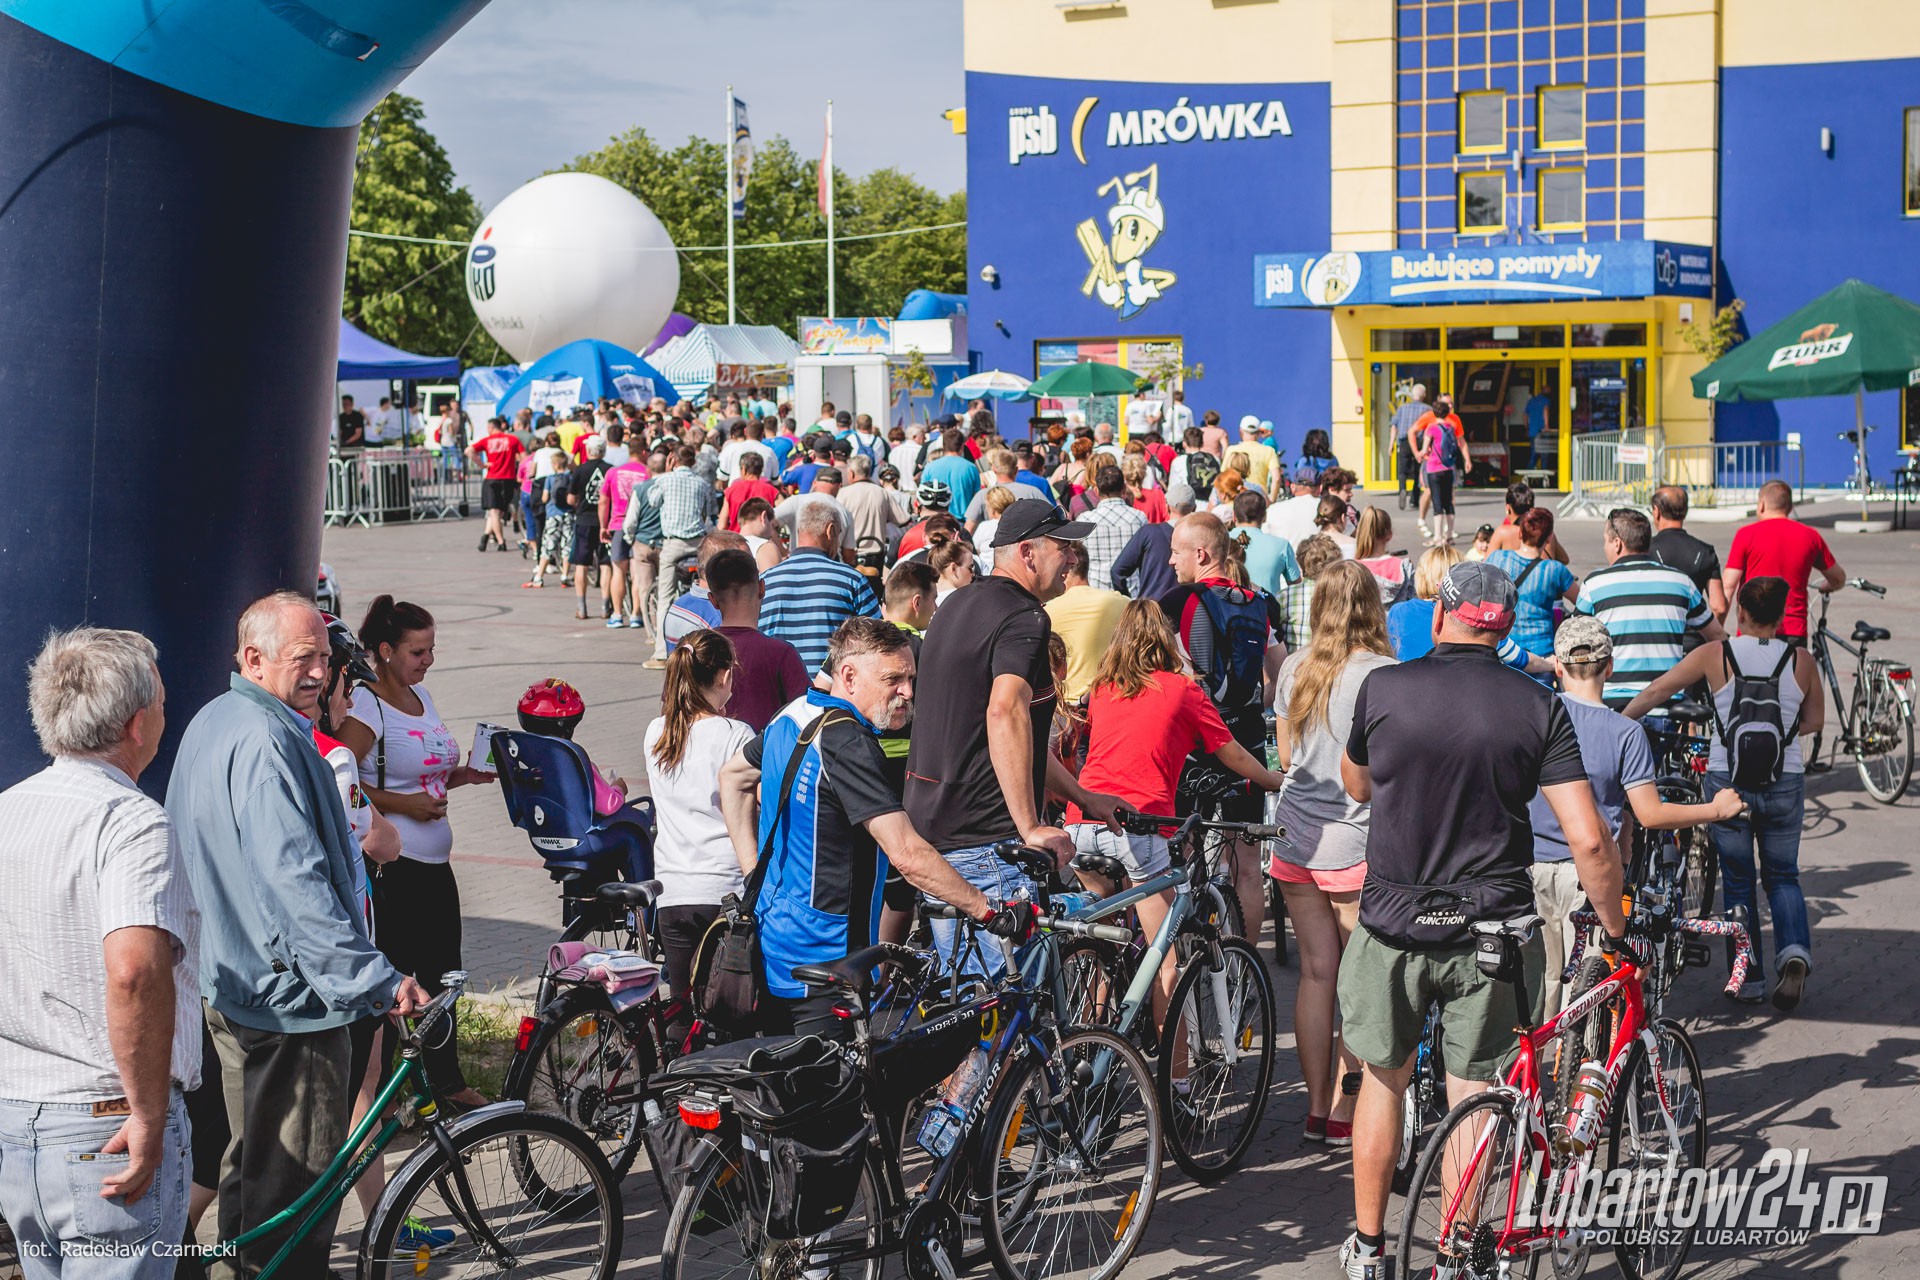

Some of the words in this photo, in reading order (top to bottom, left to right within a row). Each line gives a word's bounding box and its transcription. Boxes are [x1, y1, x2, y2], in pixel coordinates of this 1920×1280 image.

[1009, 105, 1057, 164] psb
[1106, 97, 1292, 146] MRÓWKA
[1265, 264, 1294, 299] psb
[1391, 252, 1494, 283] Budujące
[1499, 247, 1602, 280] pomysły
[1415, 915, 1467, 926] FUNCTION
[963, 1061, 1002, 1138] AUTHOR
